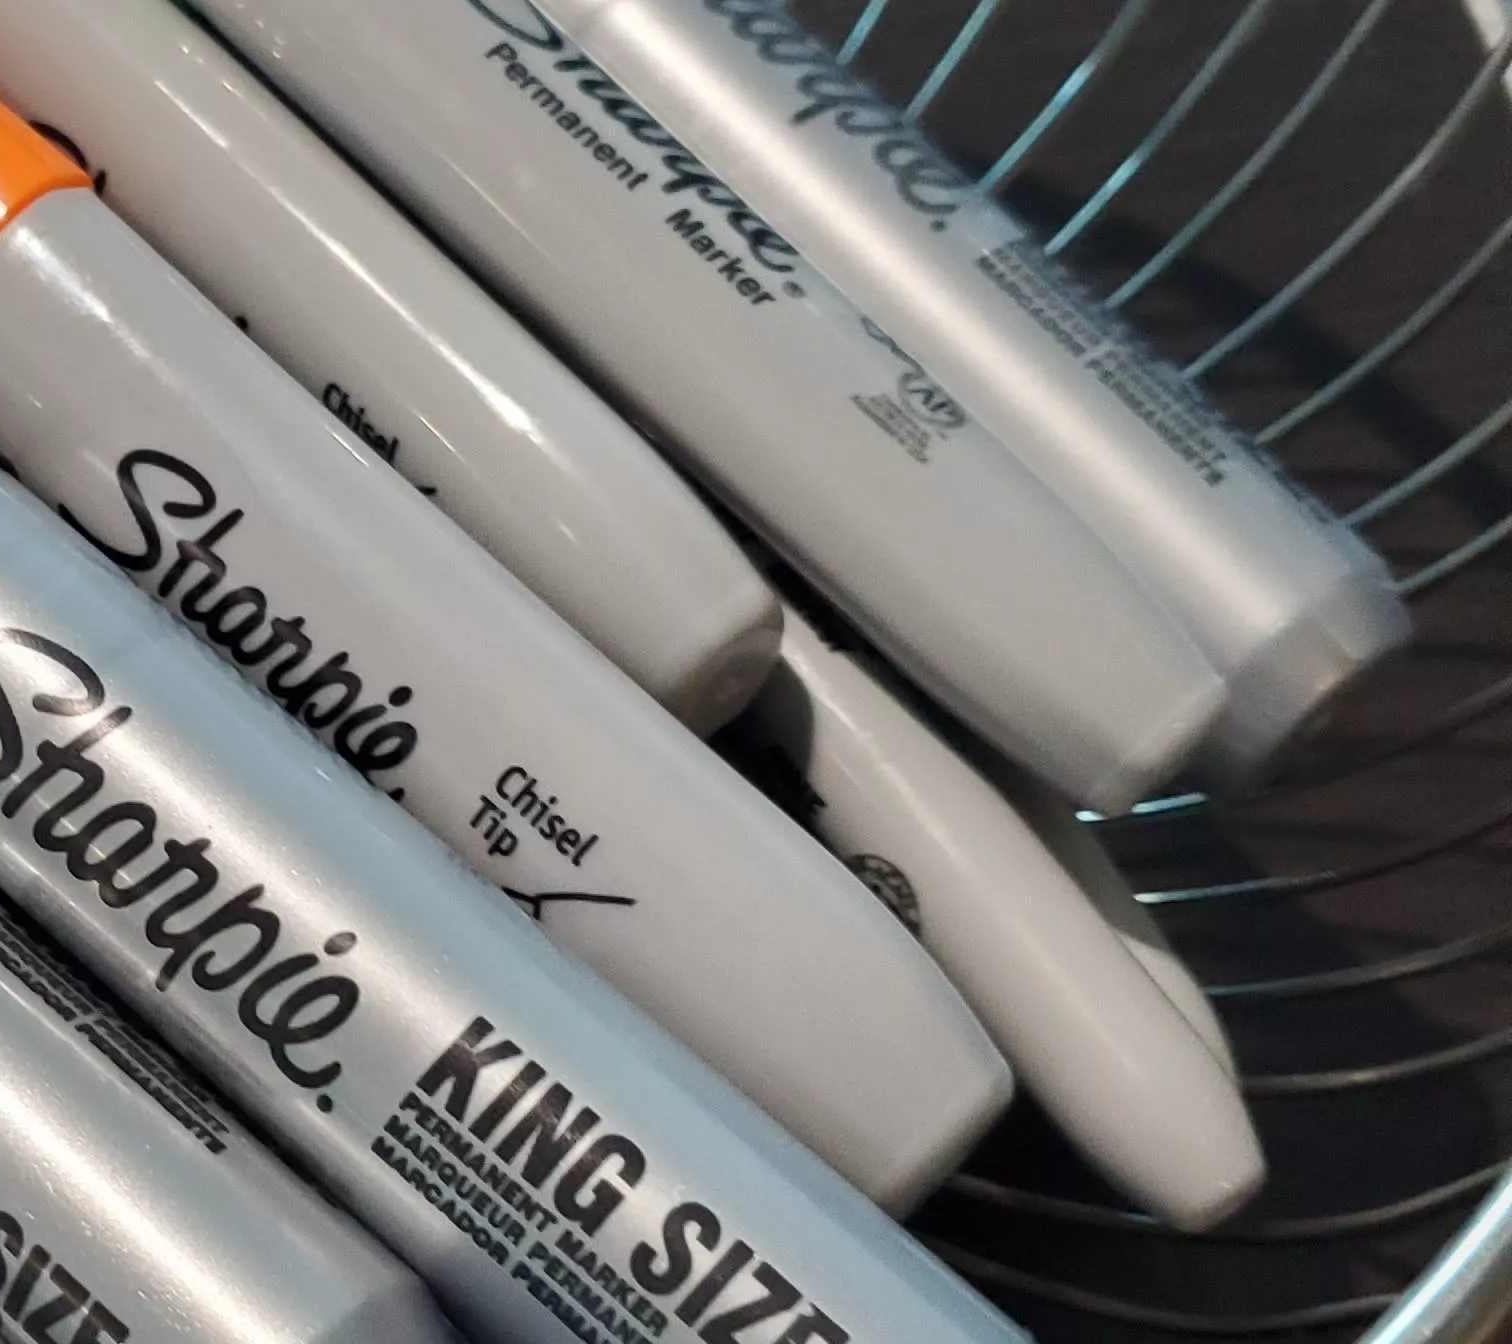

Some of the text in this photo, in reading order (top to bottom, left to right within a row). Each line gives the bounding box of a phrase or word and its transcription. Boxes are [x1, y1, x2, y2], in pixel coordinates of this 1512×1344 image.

[485, 42, 778, 305] Permanent Marker
[469, 795, 520, 860] Tip
[495, 764, 600, 868] Chisel
[383, 1114, 527, 1248] MARQUEUR
[415, 1015, 647, 1238] KING
[370, 1135, 510, 1265] MARCADOR
[399, 1091, 669, 1338] PERMANENT MARKER
